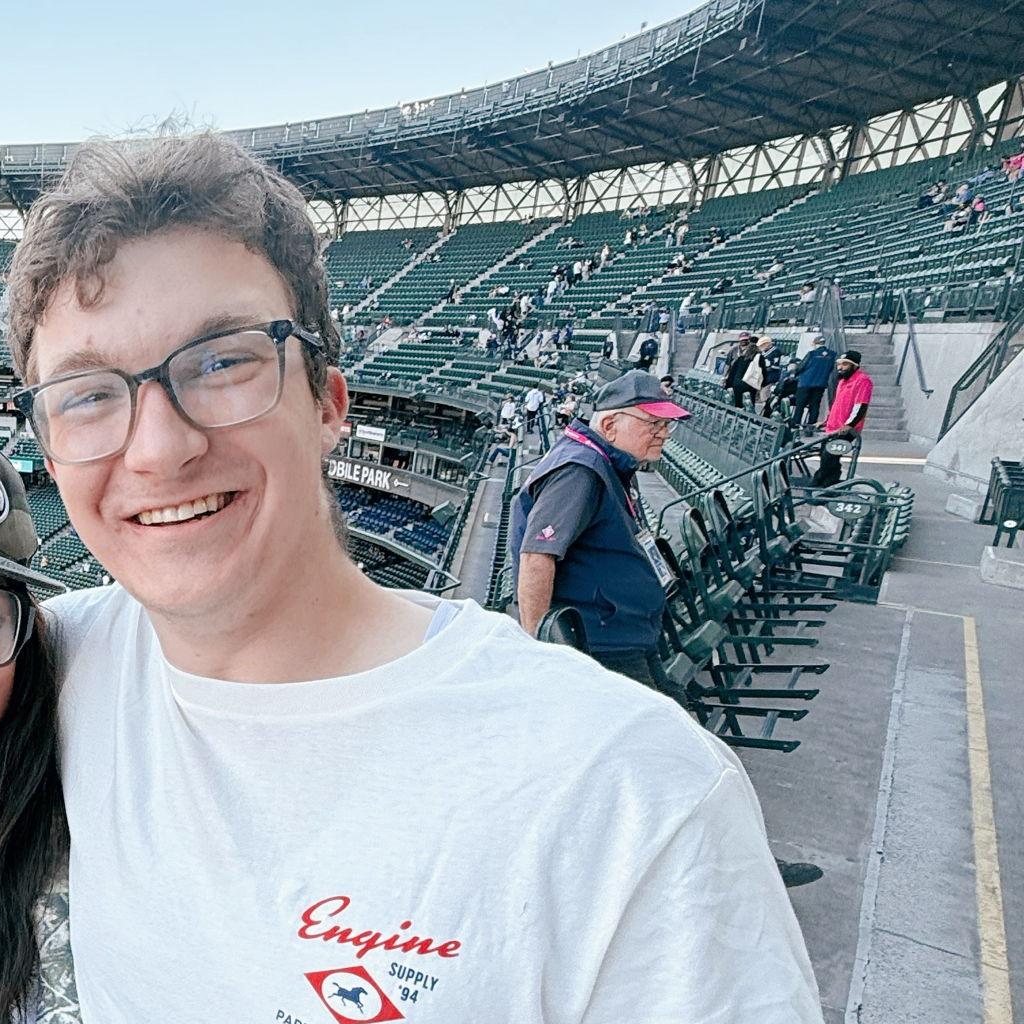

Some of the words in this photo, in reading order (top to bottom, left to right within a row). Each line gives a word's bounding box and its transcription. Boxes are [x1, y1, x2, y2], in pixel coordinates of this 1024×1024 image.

[361, 465, 391, 489] PARK
[836, 502, 862, 513] 342
[298, 895, 462, 959] Engine
[388, 962, 439, 991] SUPPLY
[398, 985, 419, 1004] '94
